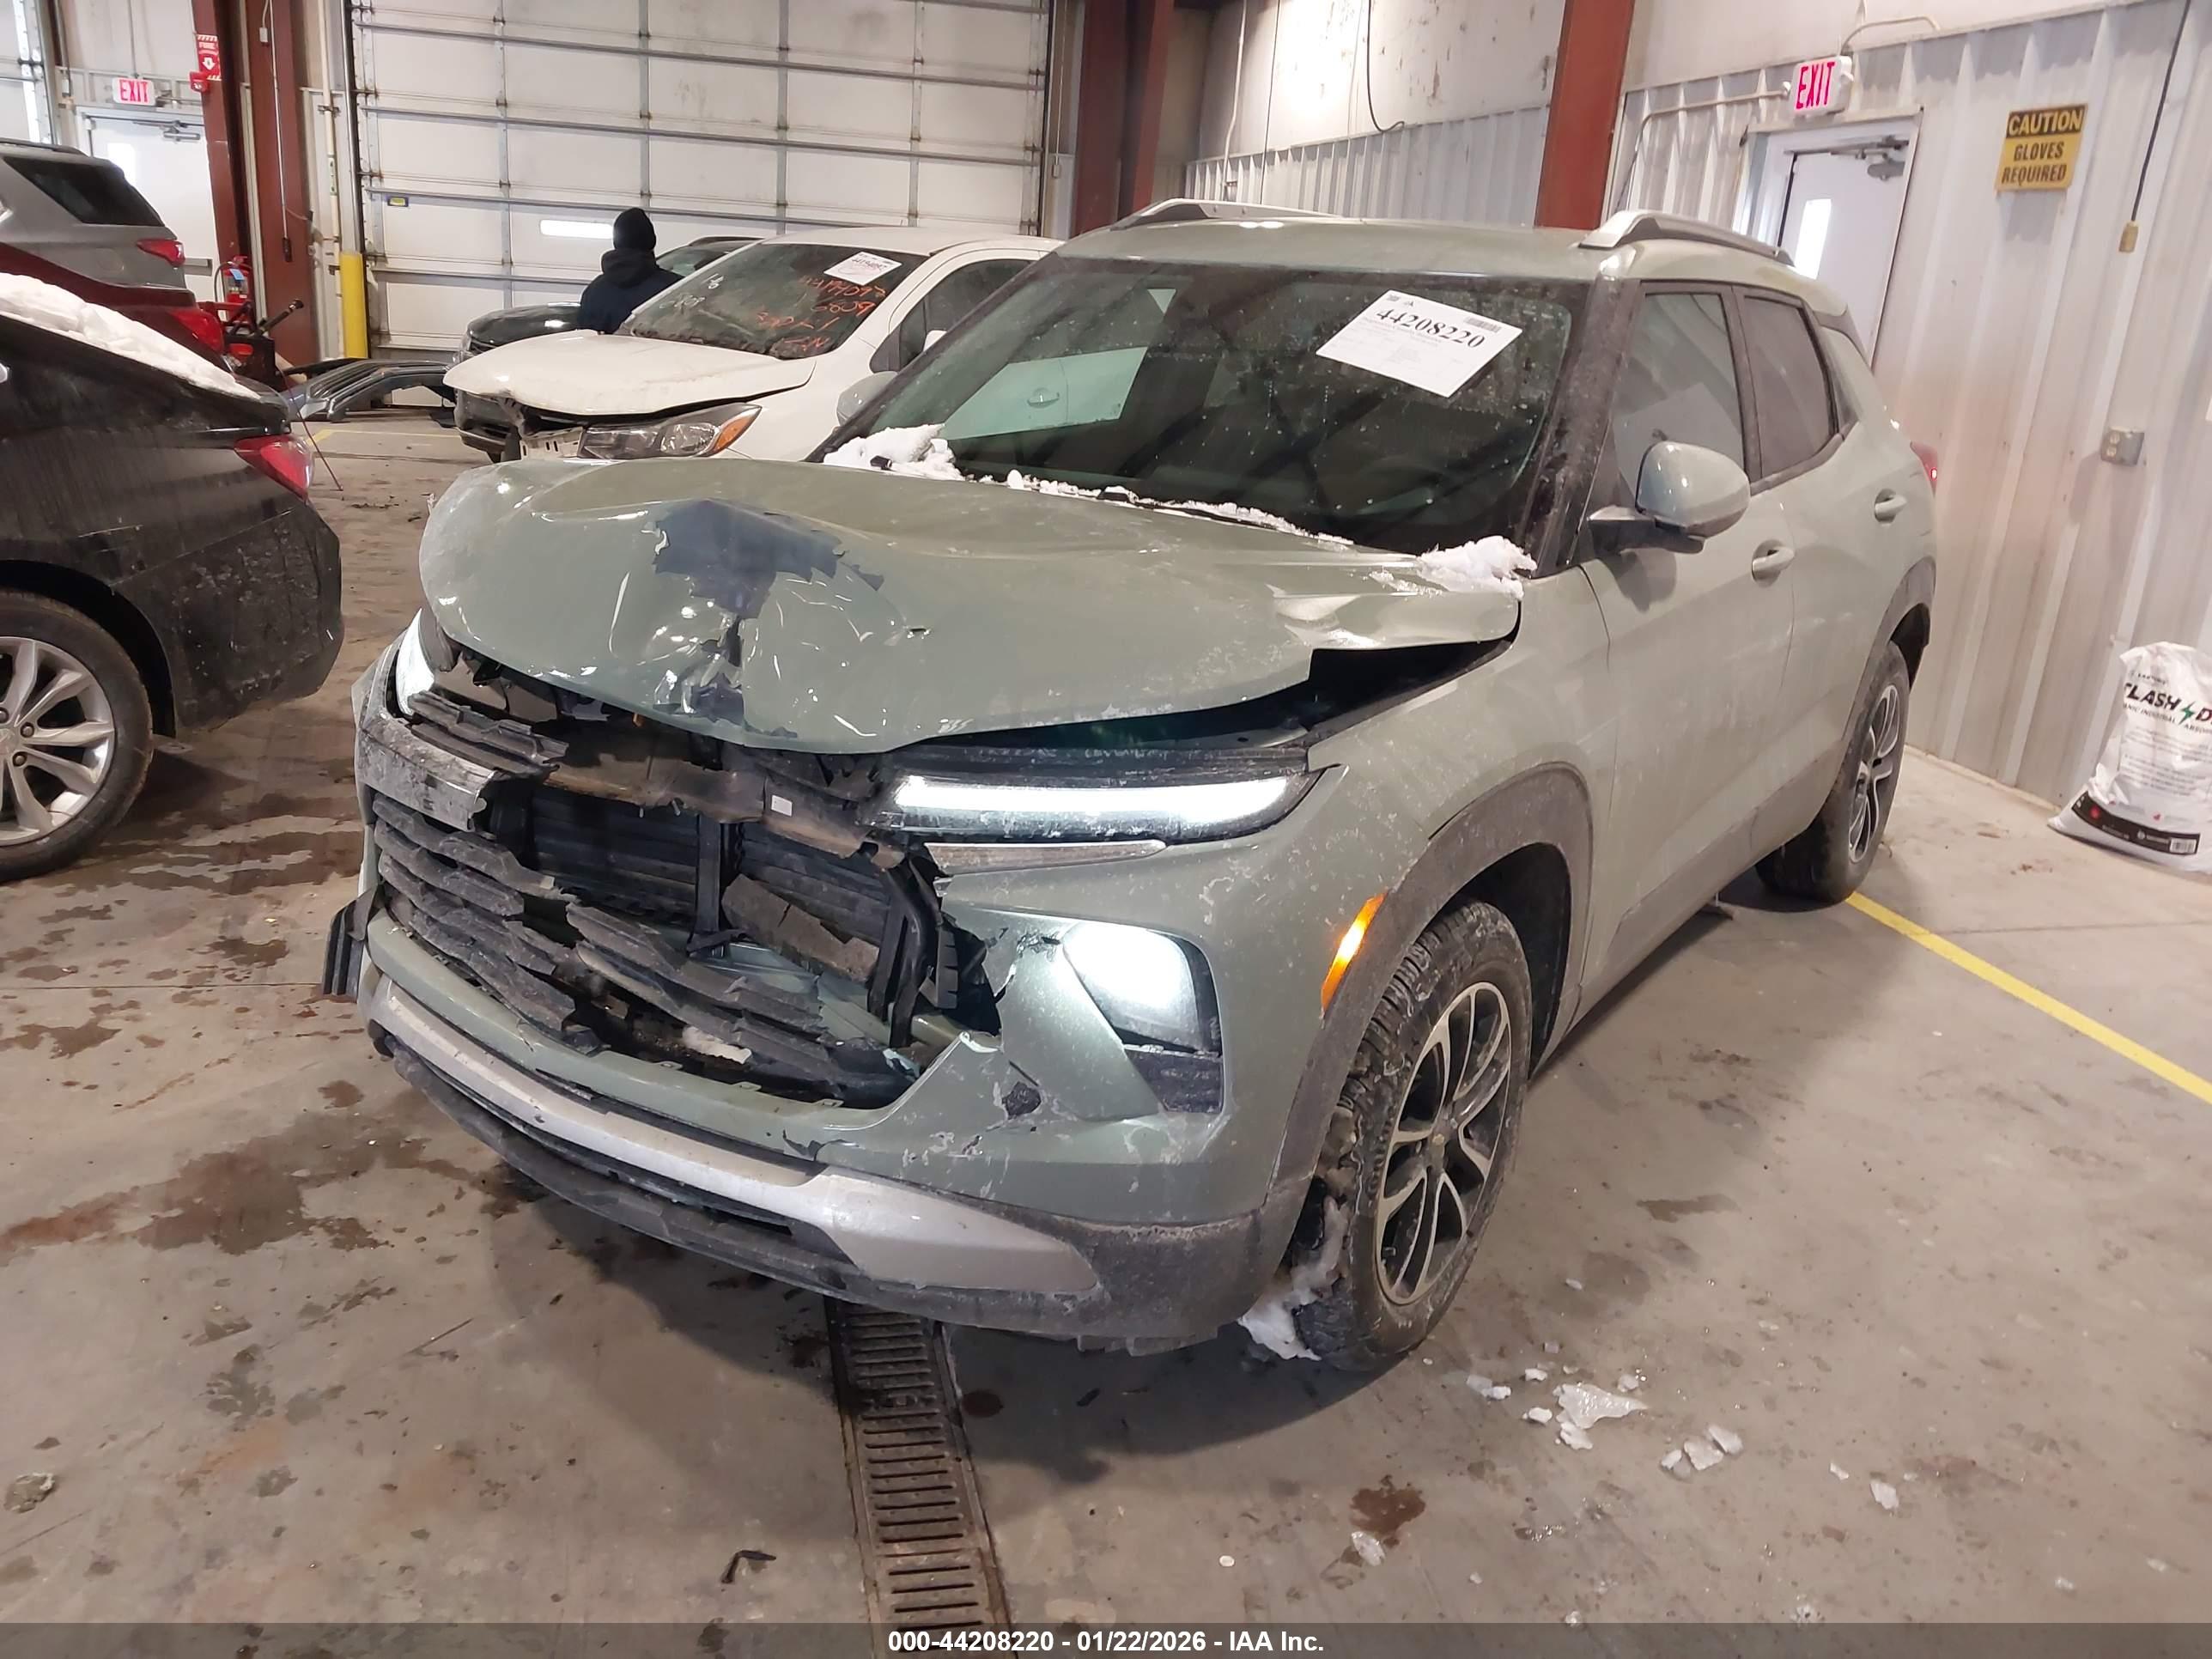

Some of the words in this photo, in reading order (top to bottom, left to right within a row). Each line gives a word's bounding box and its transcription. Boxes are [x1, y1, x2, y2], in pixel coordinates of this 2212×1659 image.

[118, 79, 148, 103] EXIT
[1796, 61, 1835, 109] EXIT
[2008, 109, 2083, 136] CAUTION
[2013, 141, 2064, 161] GLOVES
[2001, 164, 2068, 186] REQUIRED
[1376, 308, 1486, 348] 44208220
